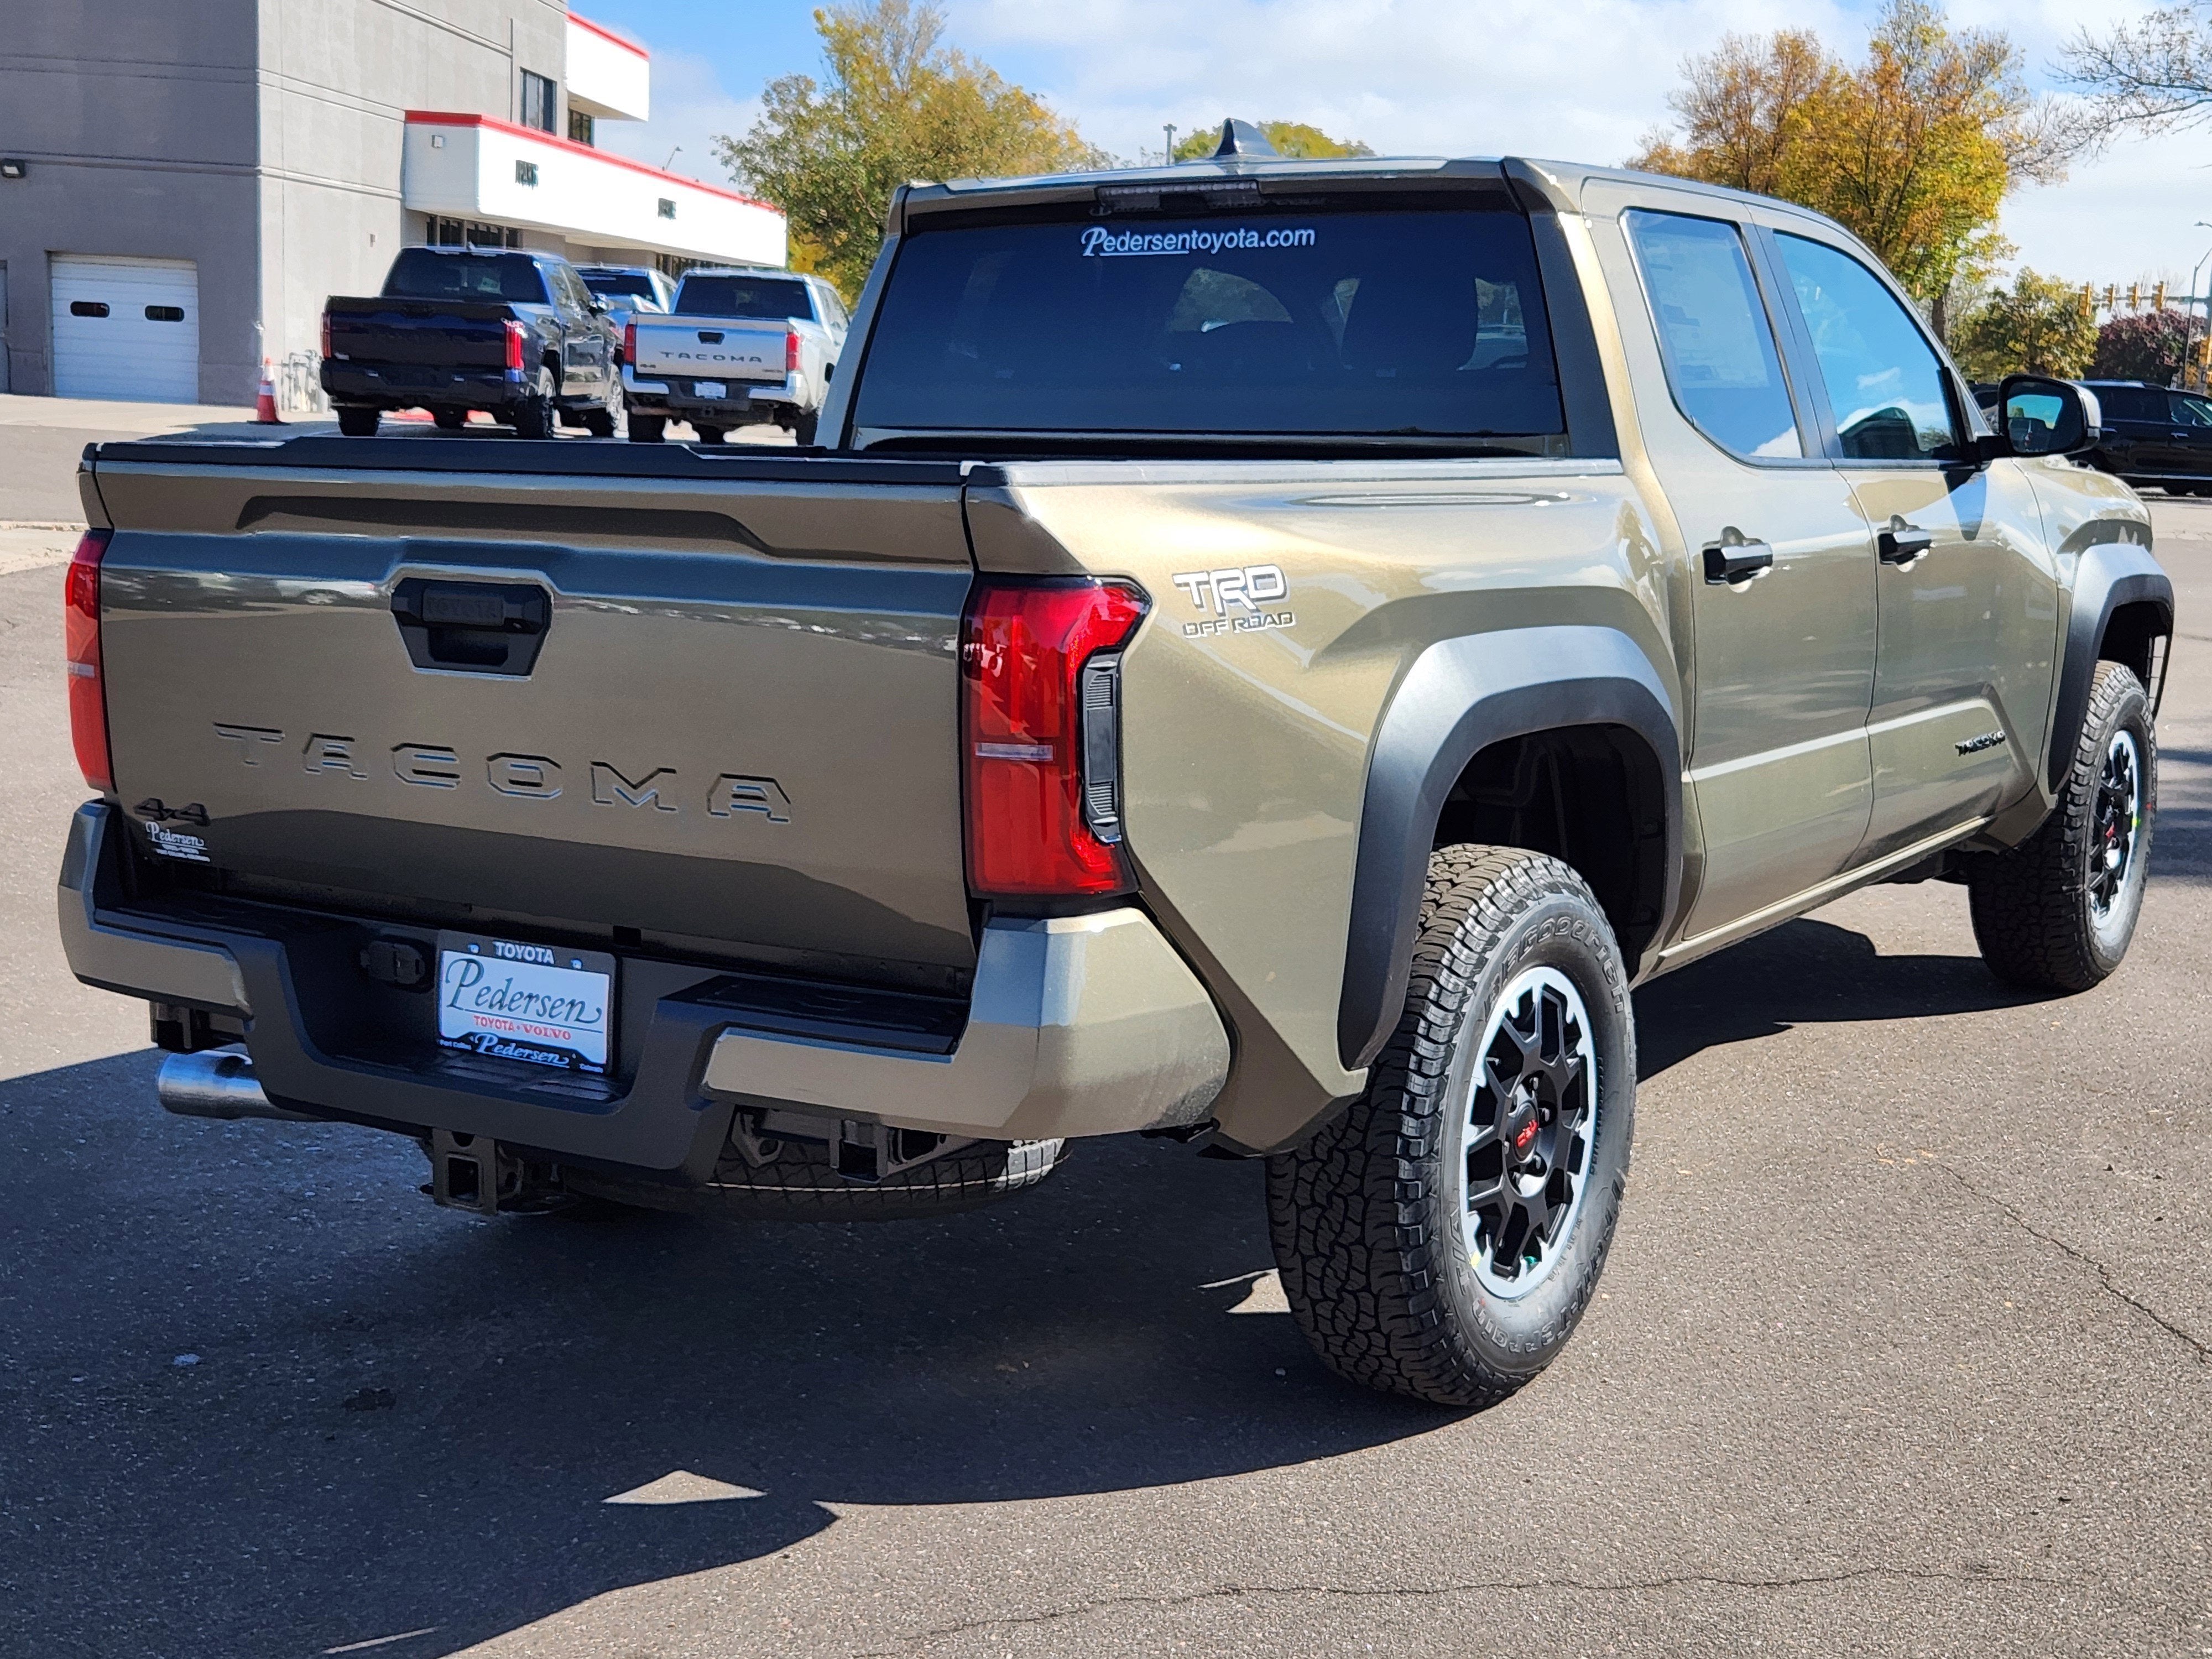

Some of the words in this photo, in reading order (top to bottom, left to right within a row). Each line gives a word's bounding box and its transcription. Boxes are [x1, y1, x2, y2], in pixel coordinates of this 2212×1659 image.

[660, 351, 762, 363] TACOMA
[1171, 564, 1288, 618] TRD
[1183, 619, 1229, 638] OFF
[1231, 611, 1296, 633] ROAD
[213, 721, 791, 824] TACOMA
[145, 821, 205, 847] Pedersen
[492, 941, 555, 964] TOYOTA
[445, 958, 603, 1024] Pedersen
[475, 1032, 570, 1064] Pedersen
